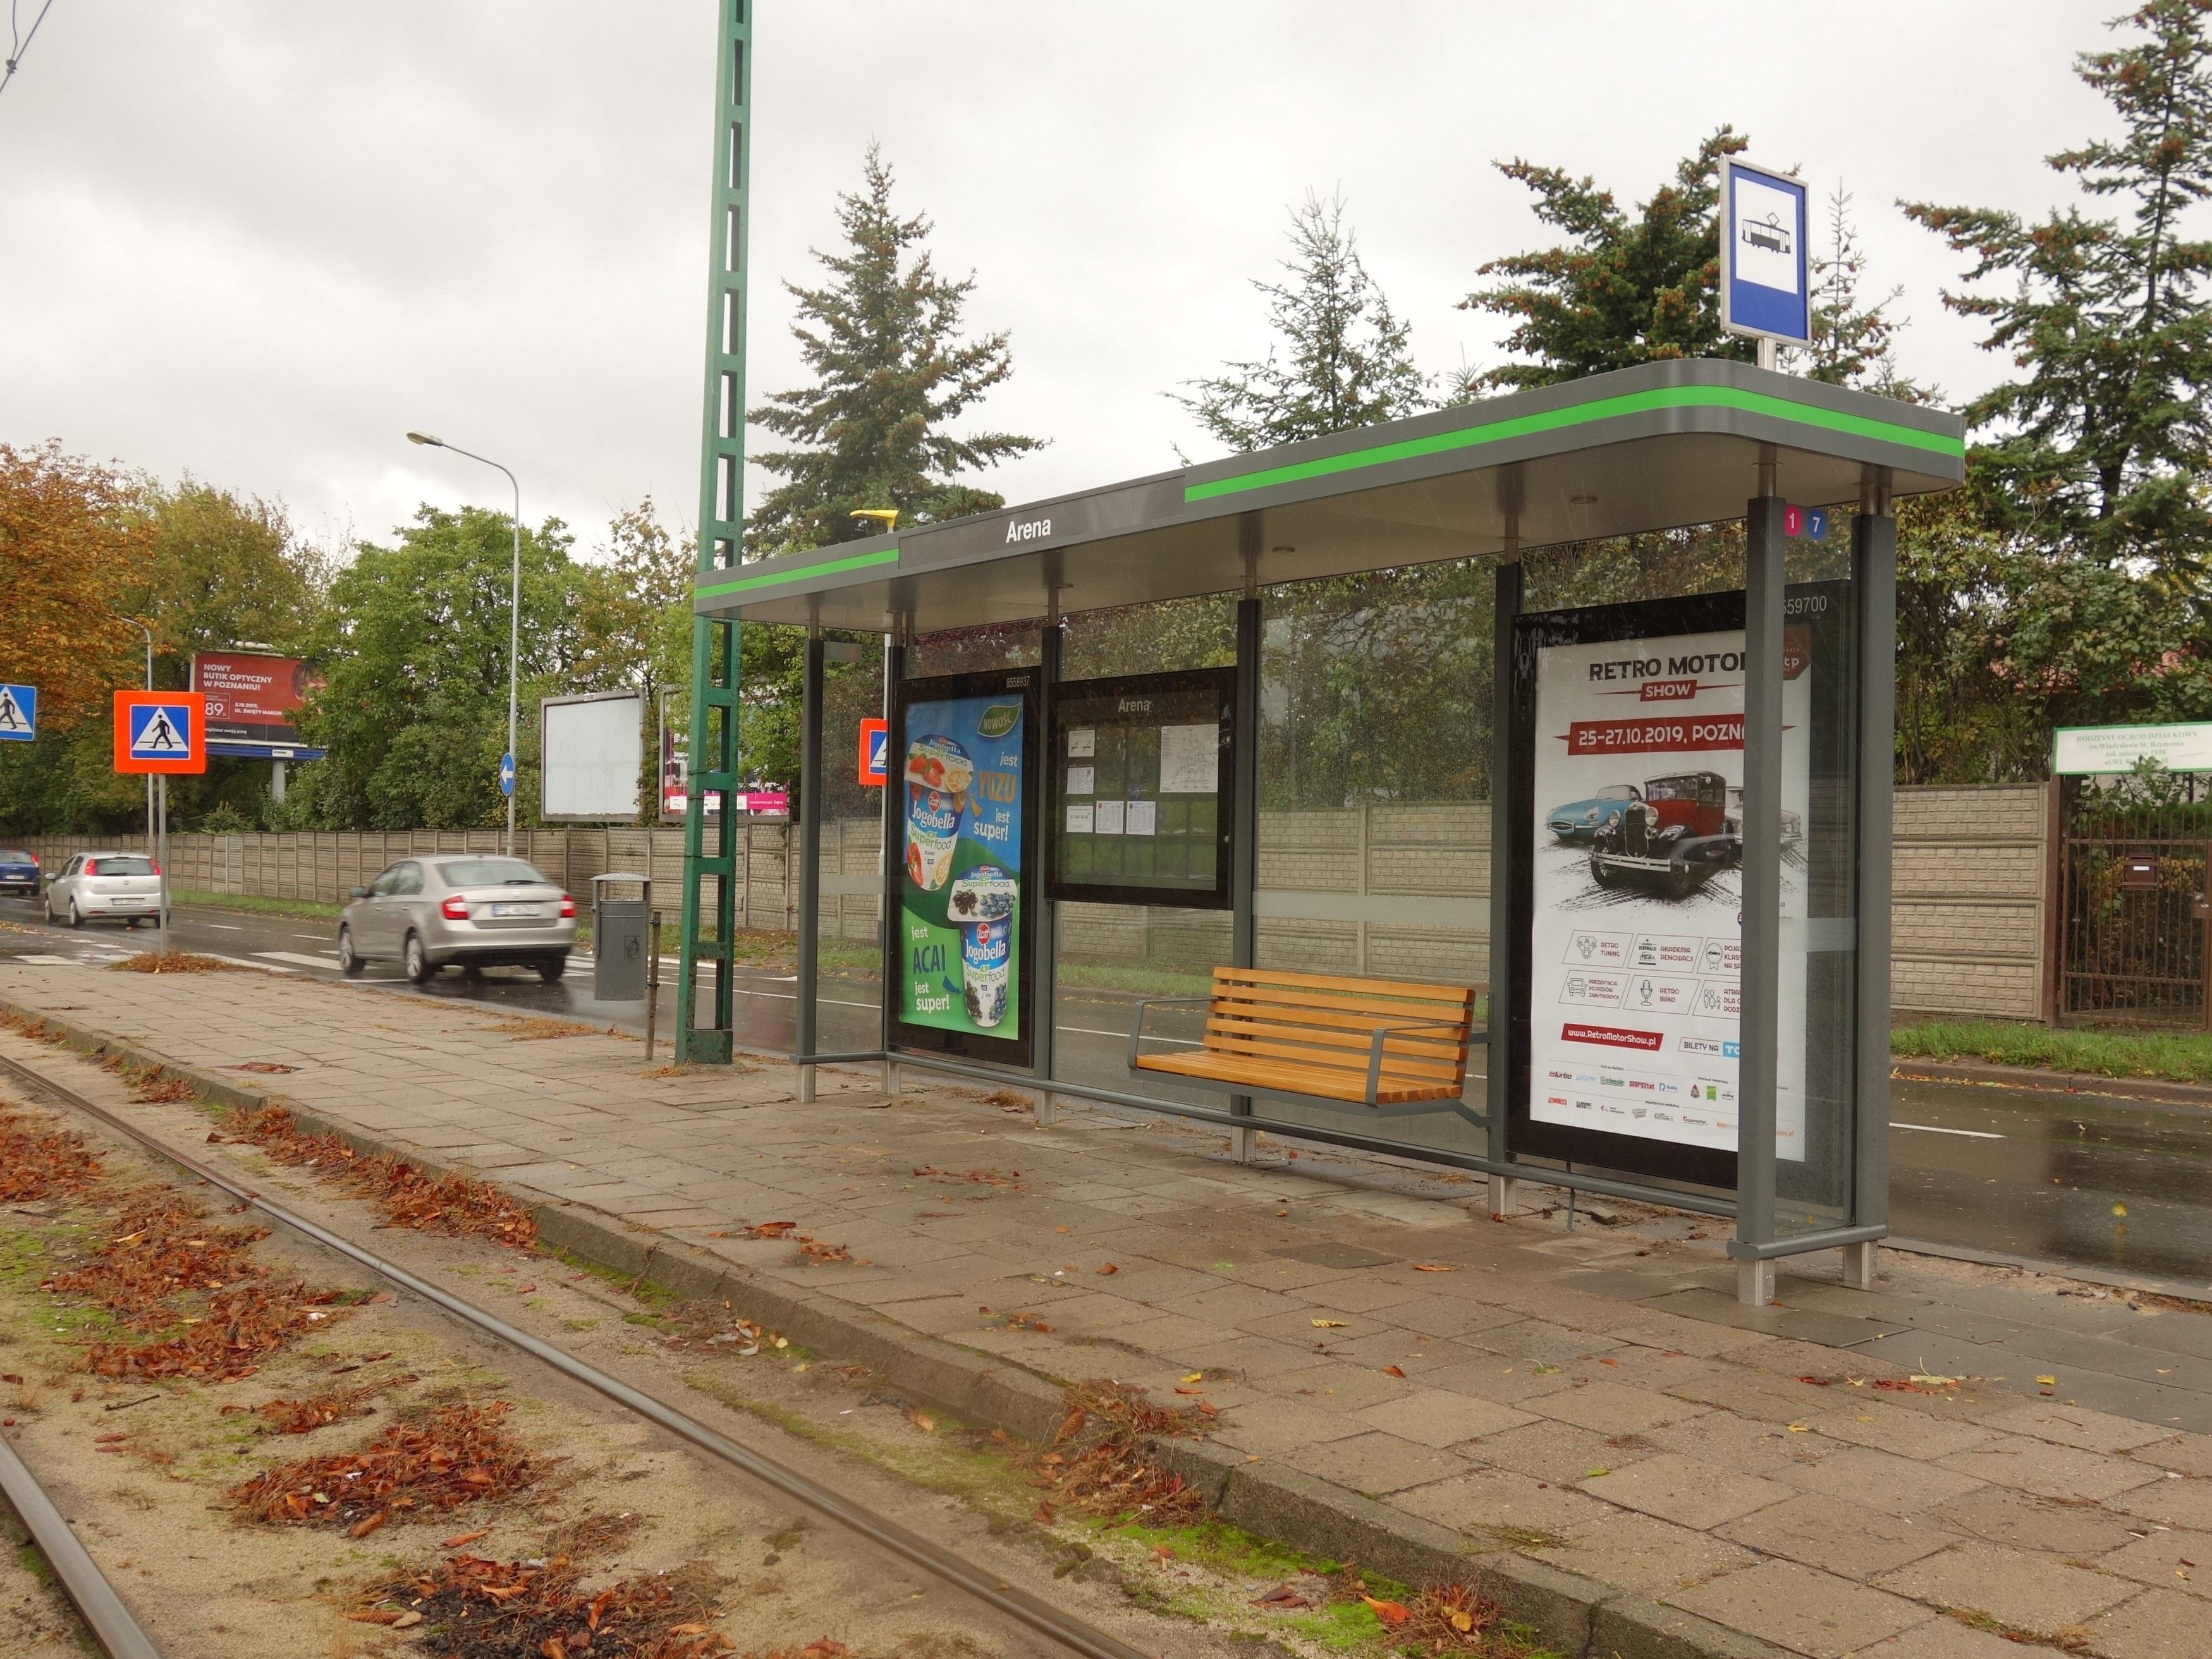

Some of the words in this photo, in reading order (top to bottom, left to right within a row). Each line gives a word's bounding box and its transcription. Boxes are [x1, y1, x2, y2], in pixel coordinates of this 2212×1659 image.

[1789, 513, 1795, 529] 1
[1812, 516, 1821, 533] 7
[1006, 519, 1051, 544] Arena
[204, 672, 228, 680] BUTIK
[229, 674, 272, 683] OPTYCZNY
[1589, 658, 1662, 681] RETRO
[214, 681, 260, 691] POZNANIU!
[1006, 676, 1030, 688] 8558937
[1646, 683, 1691, 698] SHOW
[205, 702, 224, 715] 89
[1118, 698, 1149, 713] Arena
[983, 712, 1011, 731] NOWOŚĆ
[1579, 726, 1688, 747] 25-27.10.2019,
[2117, 731, 2147, 740] OGRÓD
[2148, 731, 2197, 739] DZIAŁKOWY
[929, 738, 961, 754] Jogobella
[999, 751, 1018, 767] jest
[977, 769, 1017, 804] YUZU
[912, 799, 956, 829] Jogobella
[995, 808, 1010, 824] jest
[974, 821, 1008, 842] super!
[911, 926, 929, 940] jest
[913, 944, 946, 975] ACAI
[965, 939, 1006, 964] Jogobella
[915, 981, 929, 996] jest
[916, 994, 950, 1014] super!
[1568, 1029, 1656, 1047] www.RetroMotorShow.pl
[1684, 1041, 1708, 1051] BILETY
[1709, 1044, 1719, 1052] NA
[1555, 1071, 1572, 1079] turbo
